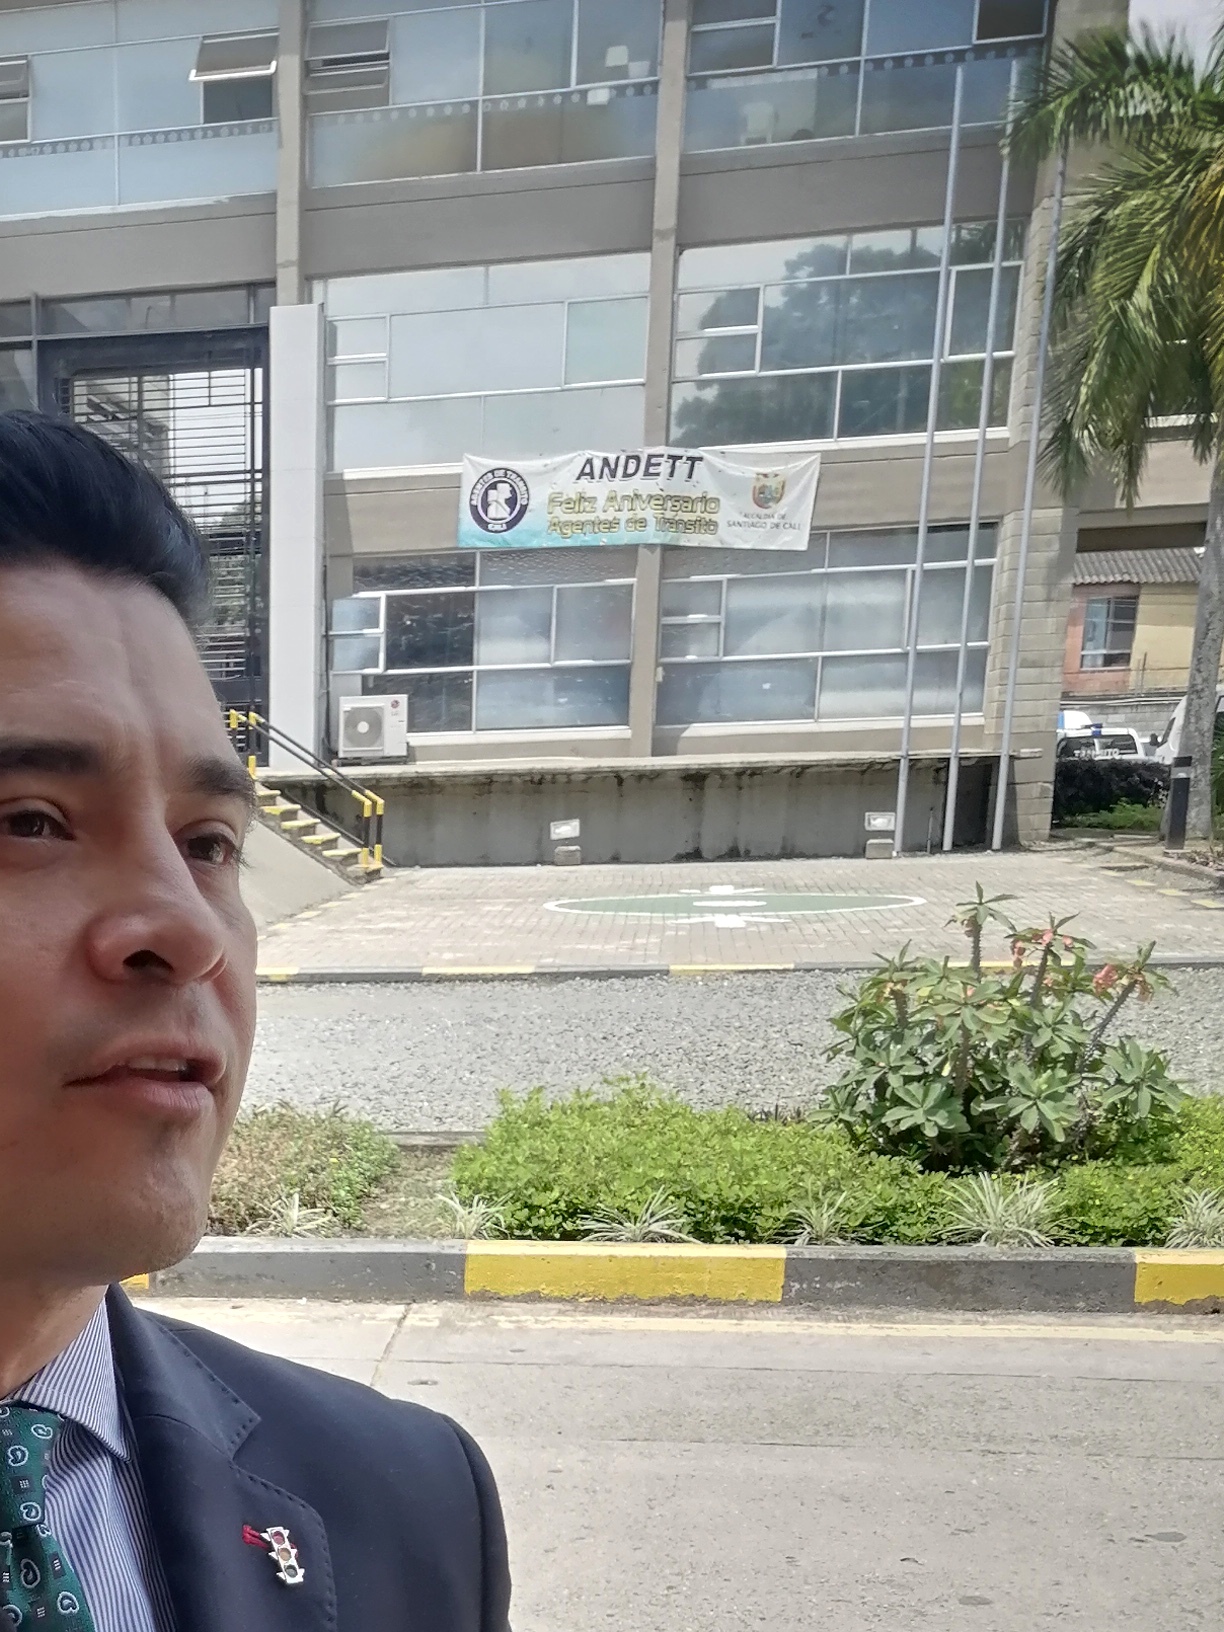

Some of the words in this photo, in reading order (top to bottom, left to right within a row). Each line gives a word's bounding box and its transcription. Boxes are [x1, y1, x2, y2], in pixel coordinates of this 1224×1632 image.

[575, 453, 704, 482] ANDETT
[547, 490, 598, 515] Feliz
[602, 488, 721, 515] Aniversario
[547, 515, 620, 539] Agentes
[623, 514, 648, 533] de
[726, 519, 767, 529] SANTIAGO
[769, 521, 780, 530] DE
